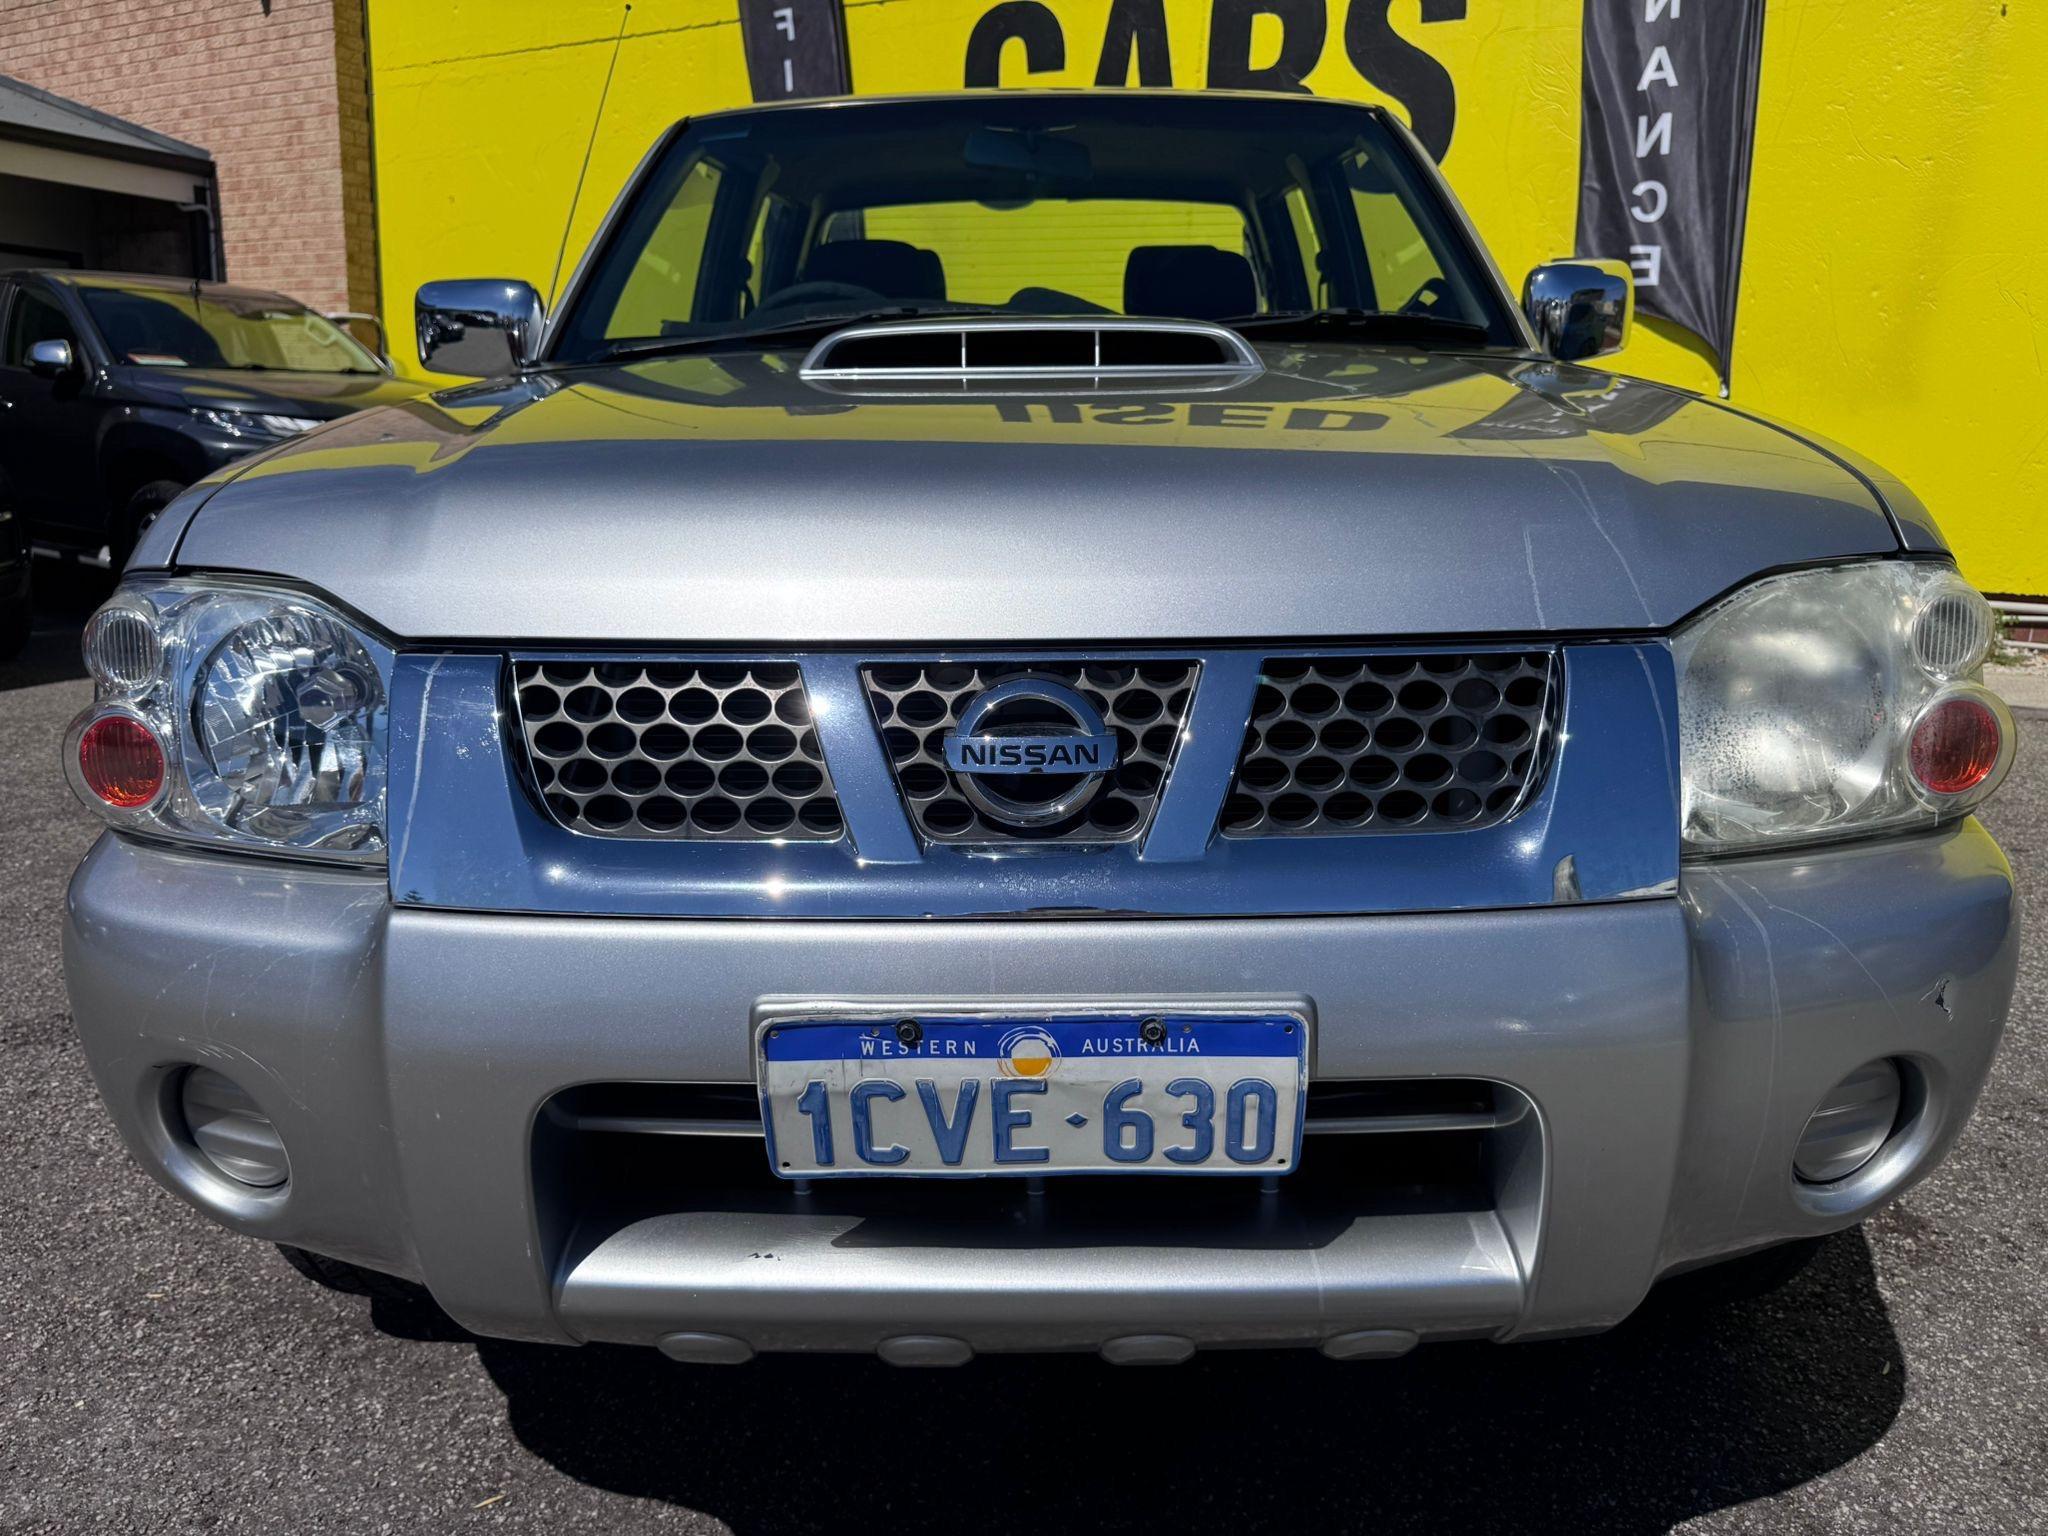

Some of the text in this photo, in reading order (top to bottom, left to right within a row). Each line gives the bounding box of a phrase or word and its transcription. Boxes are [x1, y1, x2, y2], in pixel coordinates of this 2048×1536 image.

[961, 743, 1099, 766] NISSAN
[861, 1038, 1200, 1056] WESTERN AUSTRALIA
